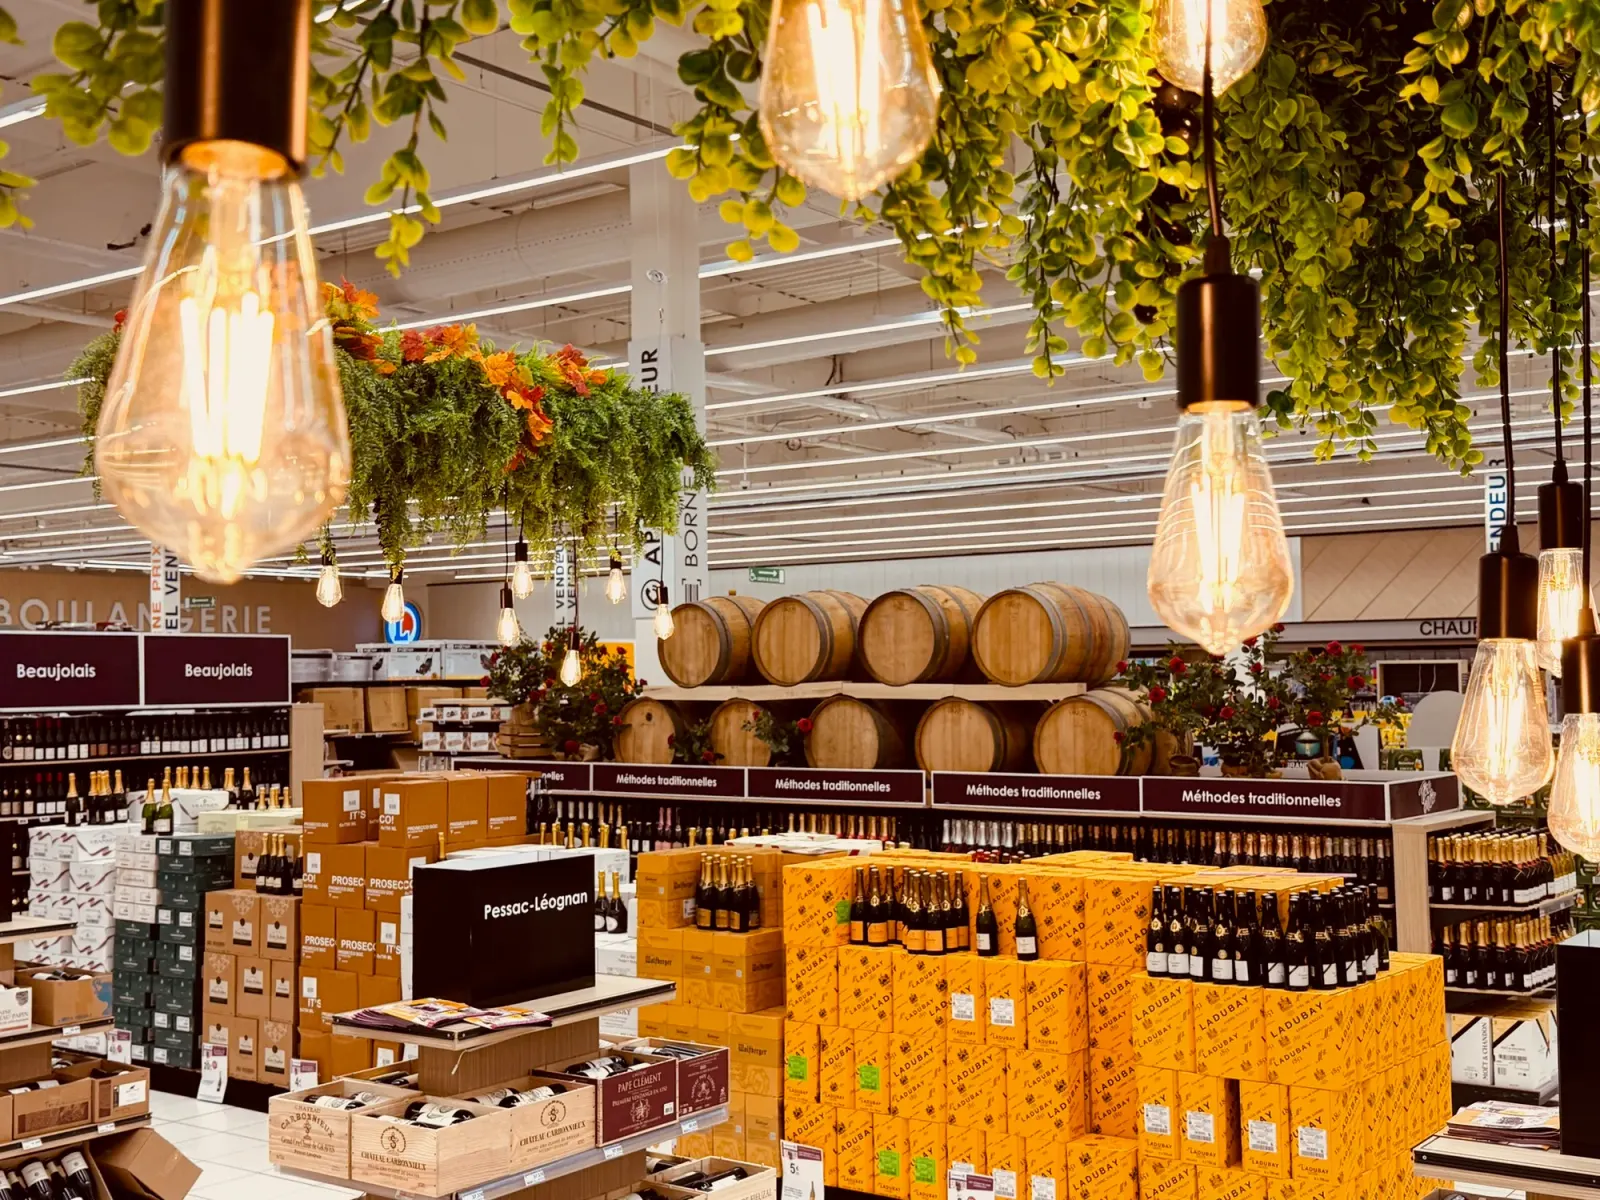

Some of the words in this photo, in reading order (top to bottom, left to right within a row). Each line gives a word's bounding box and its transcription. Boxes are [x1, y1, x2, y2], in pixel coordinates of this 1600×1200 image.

[152, 546, 161, 591] PRIX
[16, 663, 97, 681] Beaujolais
[184, 663, 253, 680] Beaujolais
[616, 774, 656, 788] Méthodes
[657, 775, 717, 787] traditionnelles
[775, 778, 820, 793] Méthodes
[823, 779, 891, 793] traditionnelles
[966, 784, 1020, 797] Méthodes
[1021, 785, 1101, 800] traditionnelles
[1181, 789, 1246, 804] Méthodes
[1247, 791, 1341, 808] traditionnelles
[801, 877, 827, 900] LADUBAY
[992, 883, 1018, 904] ADUBAY
[1047, 886, 1078, 911] LADUBAY
[484, 891, 588, 920] Pessac-Léognan
[1106, 890, 1140, 916] LADUBAY
[794, 908, 822, 932] LADUBAY
[1040, 919, 1071, 944] LADUBAY
[305, 935, 337, 948] PROSEC
[1100, 925, 1133, 950] LADUBAY
[790, 953, 828, 984] LADUBAY
[856, 960, 884, 983] LADUBAY
[911, 965, 941, 989] LADUBAY
[791, 985, 819, 1008] LADUBAY
[850, 991, 877, 1015] LADUBAY
[1091, 979, 1131, 1008] LADUBA
[1135, 986, 1183, 1021] LADUBAY
[905, 998, 934, 1021] LADUBAY
[1199, 994, 1249, 1031] LADUBAY
[1270, 1001, 1323, 1038] LADUBAY
[1094, 1010, 1126, 1034] LADUBAY
[1139, 1024, 1173, 1048] LADUBAY
[1203, 1033, 1239, 1058] LADUBAY
[893, 1046, 934, 1077] LADUBAY
[1274, 1041, 1312, 1067] LADUBAY
[950, 1054, 993, 1085] LADUBAY
[1028, 1065, 1059, 1088] LADUBAY
[1095, 1067, 1135, 1095] LADUBA
[618, 1080, 632, 1093] PAPE
[633, 1072, 662, 1089] CLÉMENT
[896, 1081, 925, 1103] LADUBAY
[952, 1089, 983, 1112] LADUBAY
[1021, 1099, 1053, 1123] LADUBAY
[1098, 1098, 1130, 1122] LADUBAY
[280, 1112, 335, 1139] CARBONNIEUX
[1073, 1158, 1119, 1191] LADUBAY
[1252, 1159, 1279, 1168] LADUBAY
[1145, 1168, 1190, 1200] LADUBAY
